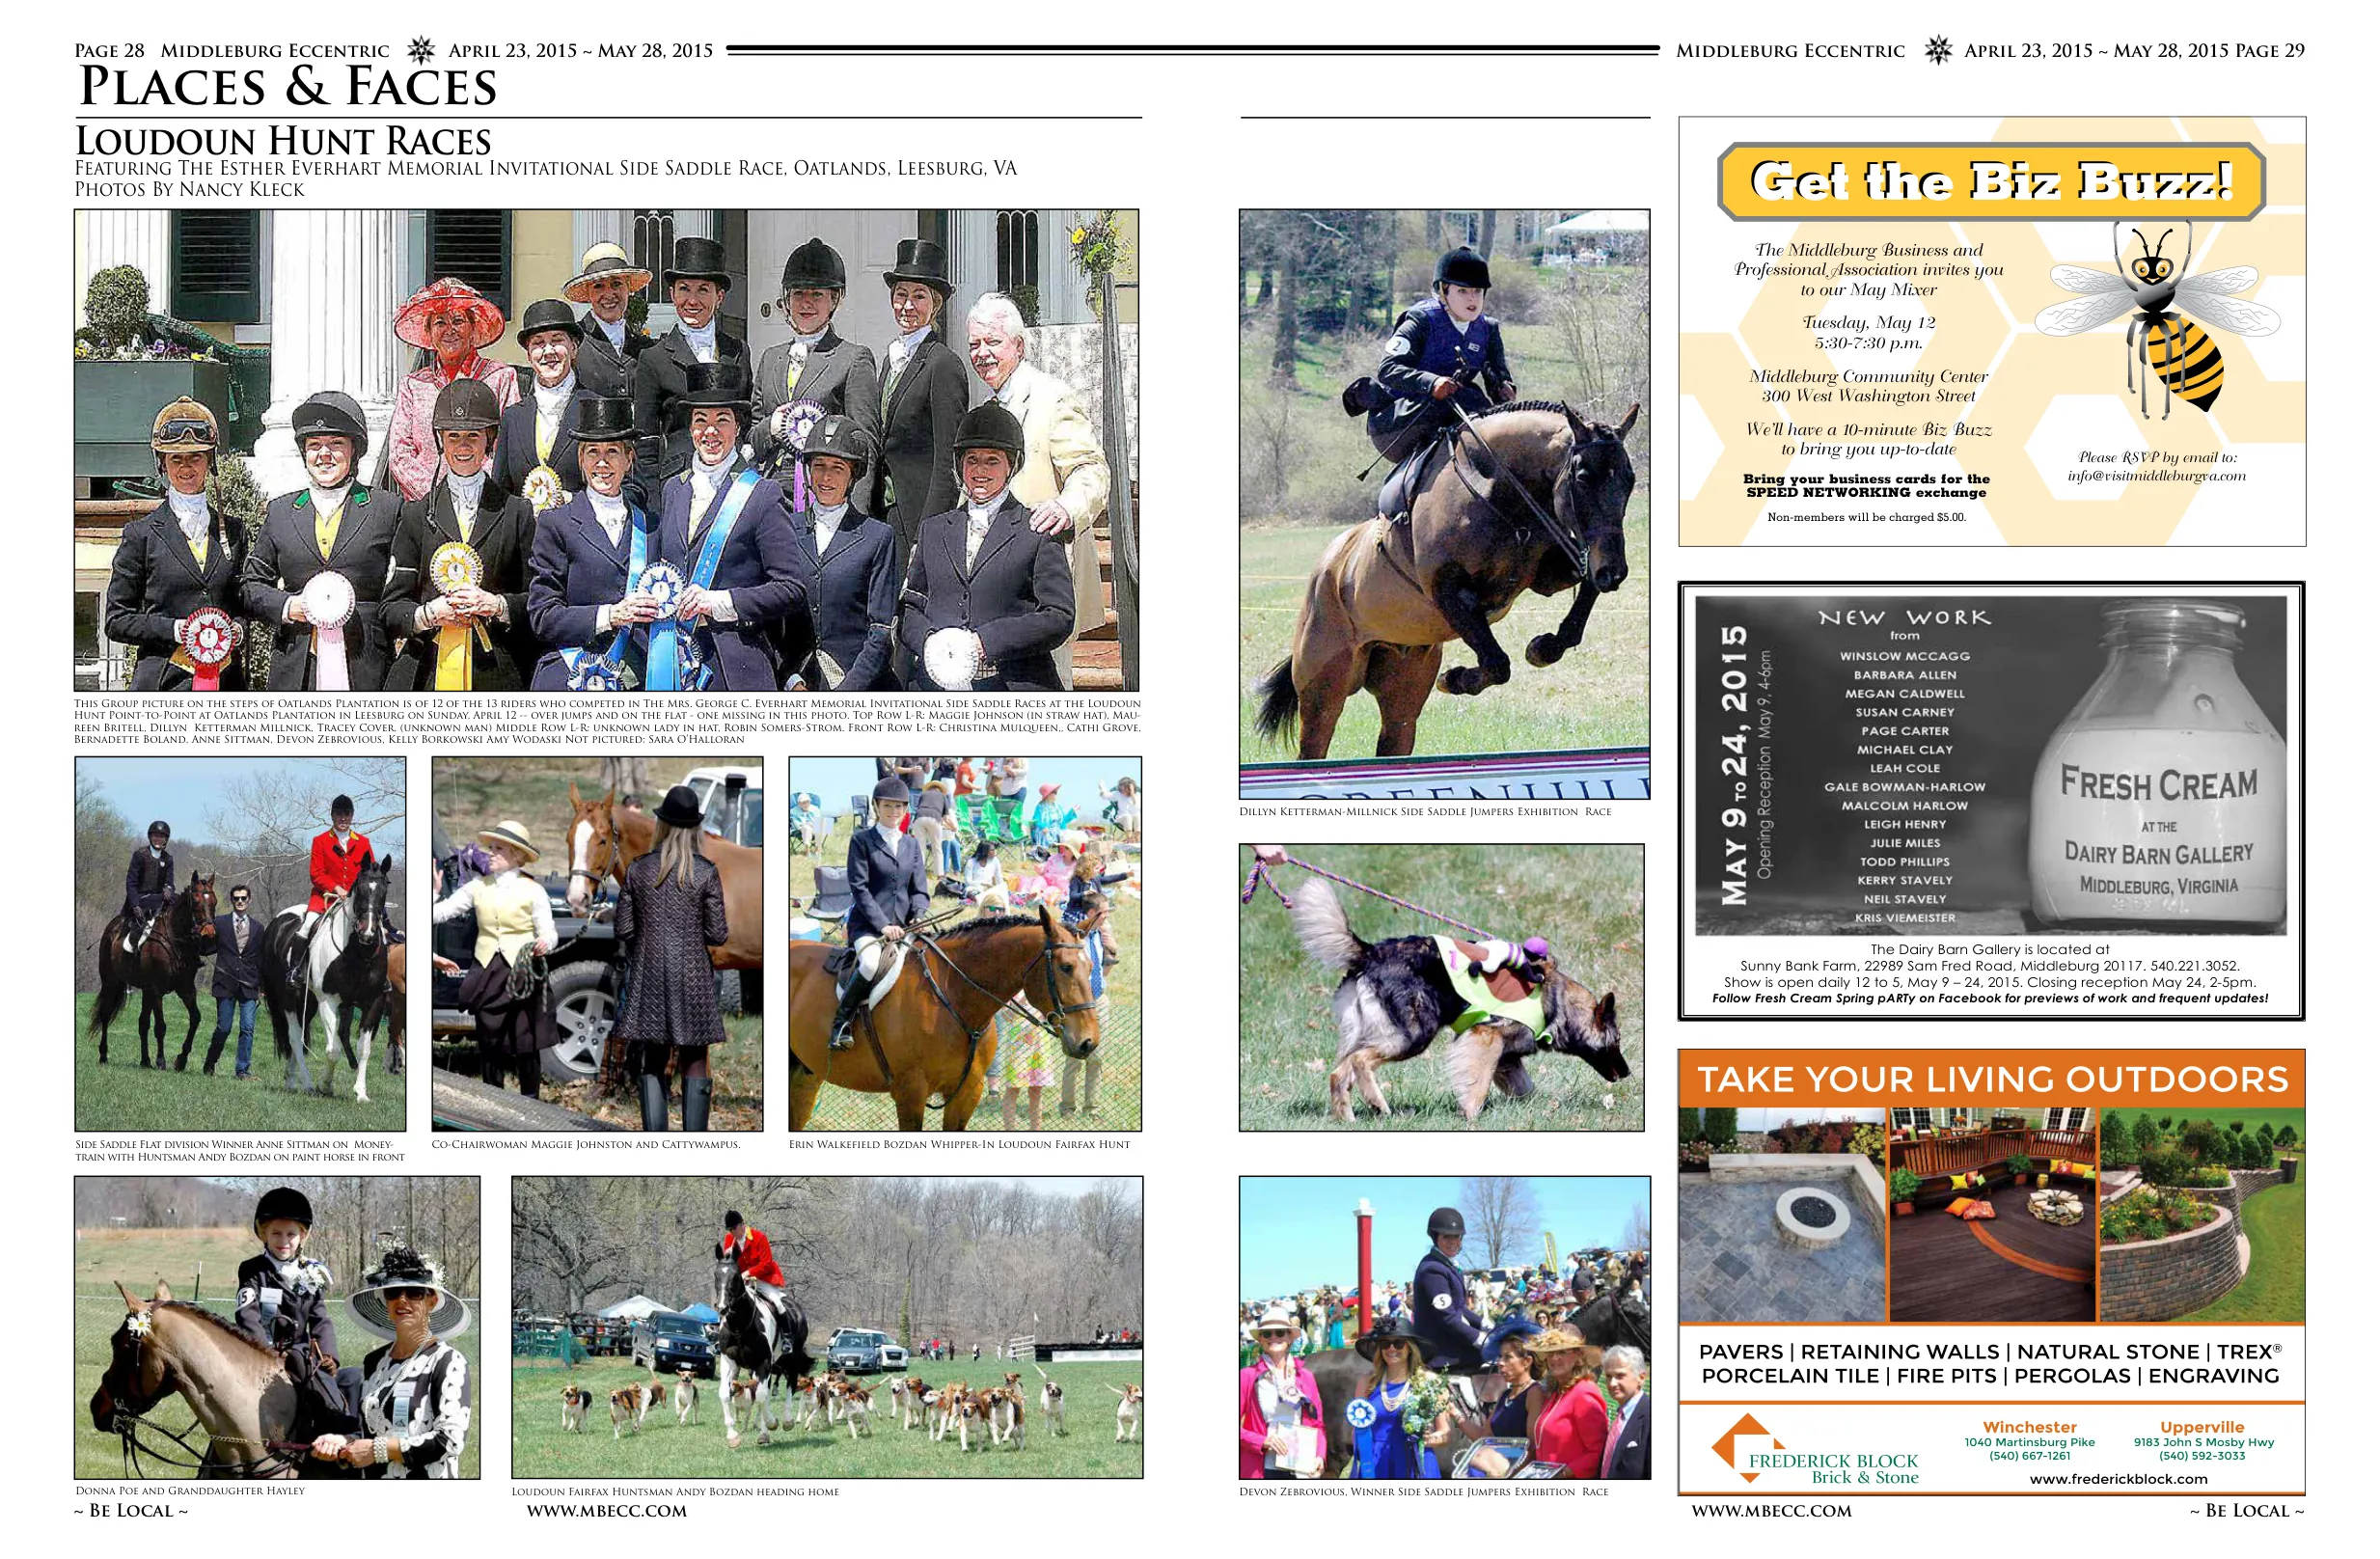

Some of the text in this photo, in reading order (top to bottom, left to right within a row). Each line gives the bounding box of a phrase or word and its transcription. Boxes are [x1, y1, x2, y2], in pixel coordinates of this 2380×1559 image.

[75, 43, 389, 58] PAGE 28 MIDDLEBURG ECCENTRIC
[449, 43, 712, 59] APRIL 23, 2015 MAY 28, 2015
[1677, 43, 1904, 57] MIDDLEBURG ECCENTRIC
[1964, 43, 2305, 59] APRIL 23, 2015 MAY 28, 2015 PAGE 29
[80, 64, 496, 105] PLACES & FACES
[76, 125, 490, 155] LOUDOUN HUNT RACES
[76, 160, 1017, 176] FEATURING THE ESTHER EVERHART MEMORIAL INVITATIONAL SIDE SADDLE RACE, OATLANDS, LEESBURG, VA
[1751, 160, 2232, 201] Get the Biz Buzz!
[76, 181, 305, 196] PHOTOS BY NANCY KLECK
[1757, 242, 1983, 260] The Middleburg Business and
[1804, 315, 1935, 333] Tuesday, May 12
[2080, 451, 2115, 462] Please
[2123, 451, 2159, 464] RSVP
[2163, 451, 2178, 466] by
[2183, 451, 2218, 462] email
[2068, 470, 2246, 484] info@visitmiddleburgva.com
[1819, 611, 1991, 625] NEW WORK
[1891, 631, 1919, 640] from
[1841, 652, 1970, 661] WINSLOW MCCAGG
[1902, 708, 1954, 717] CARNEY
[677, 734, 744, 743] O'HALLORAN
[1721, 626, 1752, 906] MAY 9 TO 24, 2015
[2062, 763, 2257, 801] FRESH CREAM
[1471, 807, 1513, 817] JUMPERS
[2142, 822, 2177, 833] AT THE
[2065, 839, 2255, 864] DAIRY BARN GALLERY
[2080, 875, 2238, 897] MIDDLEBURG, VIRGINIA
[1854, 914, 1956, 923] KRIS VIEMEISTER
[1872, 944, 2110, 957] The Dairy Barn Gallery is located at
[1698, 1066, 2287, 1092] TAKE YOUR LIVING OUTDOORS
[577, 1140, 632, 1150] JOHNSTON
[1701, 1345, 1783, 1359] PAVERS
[1802, 1345, 1920, 1359] RETAINING
[1927, 1345, 1999, 1359] WALLS
[2018, 1345, 2120, 1359] NATURAL
[2126, 1344, 2199, 1359] STONE
[1983, 1421, 2077, 1433] Winchester
[2161, 1421, 2244, 1436] Upperville
[1750, 1455, 1918, 1467] FREDERICK BLOCK
[1990, 1448, 2069, 1462] (540) 667-1261
[1813, 1470, 1919, 1484] Brick & Stone
[2030, 1473, 2207, 1484] www.frederickblock.com
[91, 1503, 174, 1517] BE LOCAL
[527, 1505, 687, 1517] WWW.MBECC.COM
[1692, 1505, 1852, 1517] WWW.MBECC.COM
[2207, 1503, 2289, 1517] BE LOCAL
